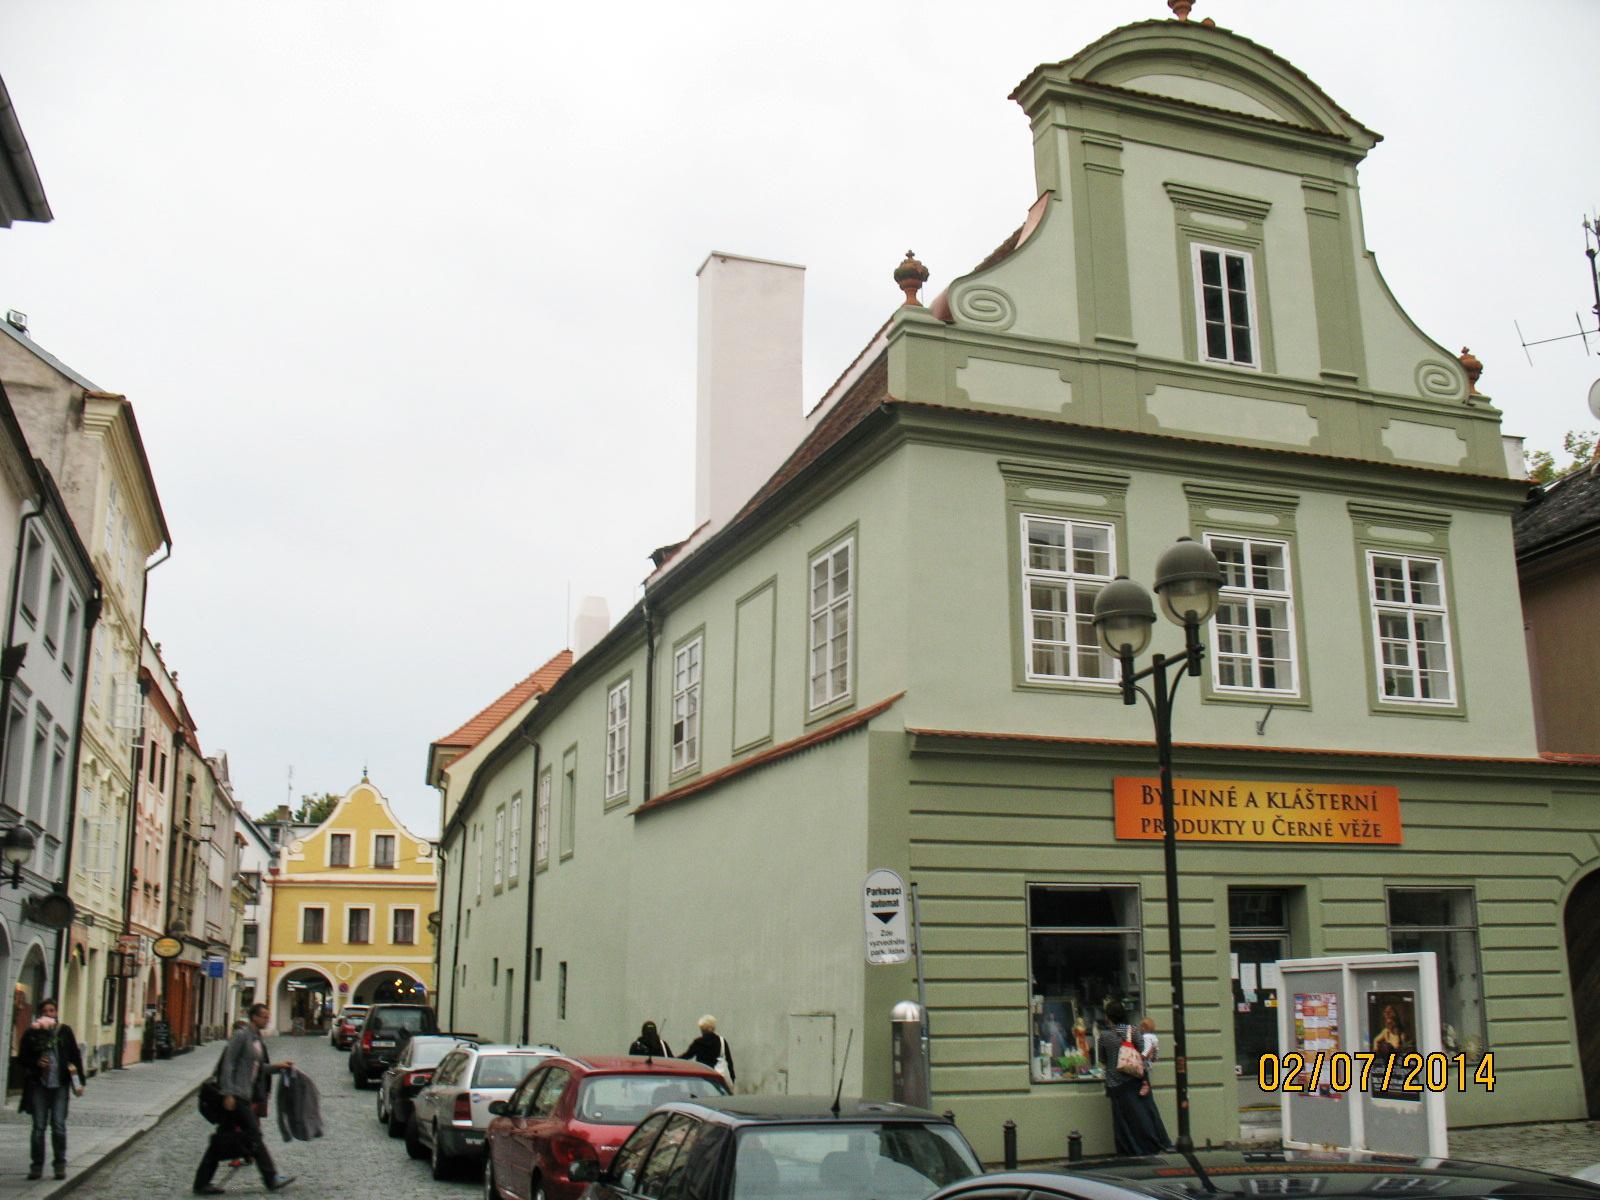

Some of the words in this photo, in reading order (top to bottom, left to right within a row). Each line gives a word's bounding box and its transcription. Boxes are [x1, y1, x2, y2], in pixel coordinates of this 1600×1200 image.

[1246, 791, 1259, 808] A
[1266, 788, 1379, 812] KLÁŠTERNÍ
[1252, 820, 1265, 836] U
[1272, 815, 1334, 837] ČERNÉ
[1339, 819, 1383, 838] VĚŽE
